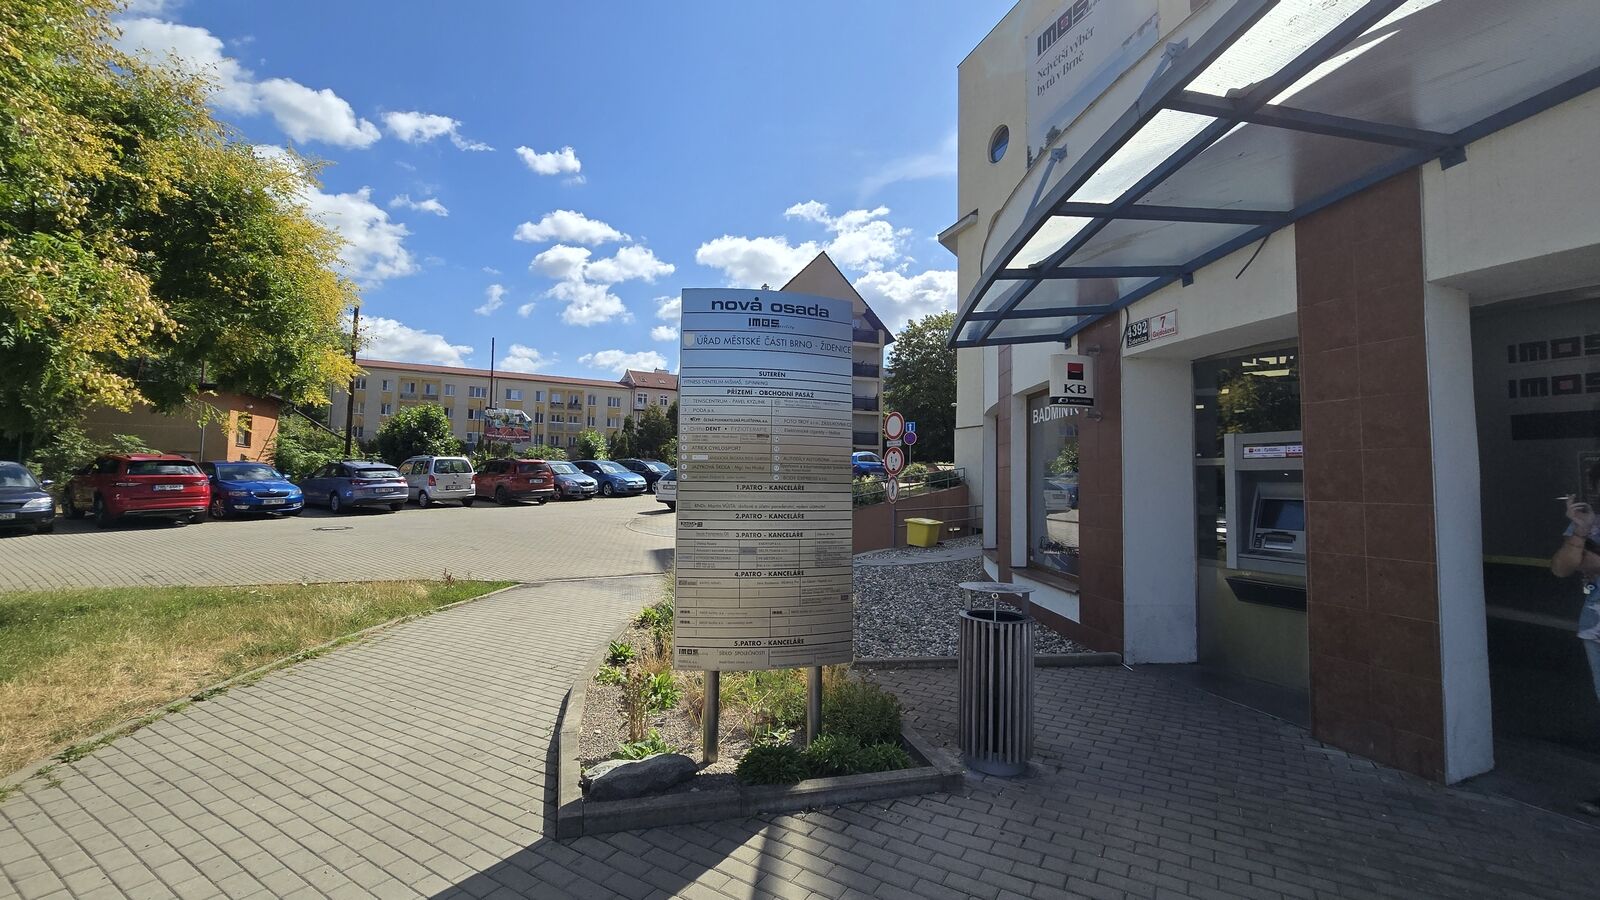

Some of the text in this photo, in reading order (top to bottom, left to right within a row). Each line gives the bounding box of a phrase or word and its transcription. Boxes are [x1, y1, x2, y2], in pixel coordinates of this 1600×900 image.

[770, 303, 830, 318] osada
[748, 317, 780, 328] IMOS
[1160, 315, 1166, 329] 7
[1127, 321, 1148, 338] 4392
[696, 334, 721, 346] ÚŘAD
[723, 334, 761, 346] MĚSTSKÉ
[764, 335, 787, 347] ČÁSTI
[789, 339, 813, 349] BRNO
[820, 340, 852, 354] ŽIDENICE
[1063, 383, 1087, 395] KB
